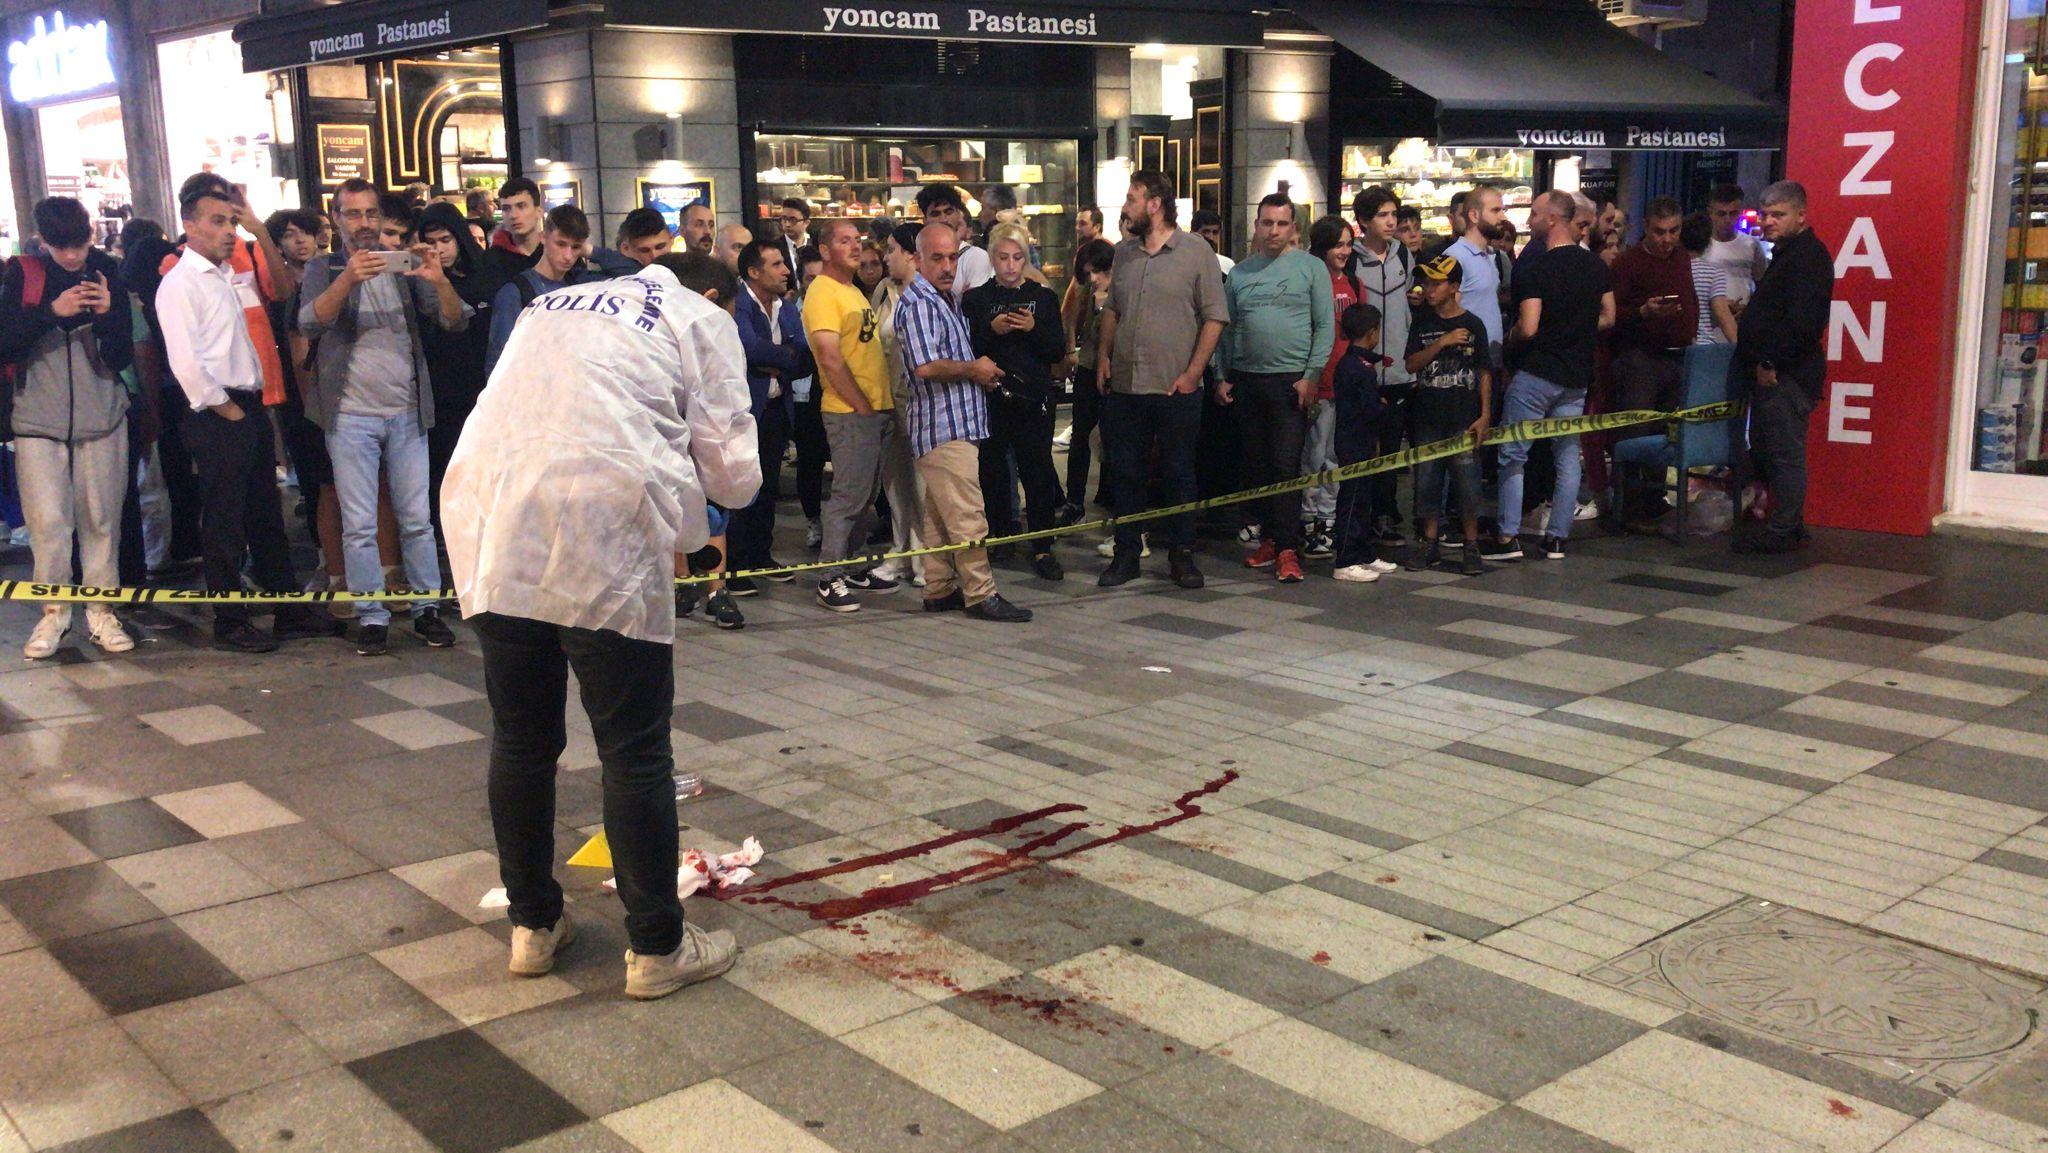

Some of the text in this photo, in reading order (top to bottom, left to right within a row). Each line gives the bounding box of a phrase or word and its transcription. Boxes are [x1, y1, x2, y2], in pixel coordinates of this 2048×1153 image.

[823, 7, 1098, 36] yoncam Pastanesi
[309, 10, 451, 61] yoncam Pastanesi
[323, 136, 365, 147] yoncam
[1516, 125, 1727, 147] yoncam Pastanesi
